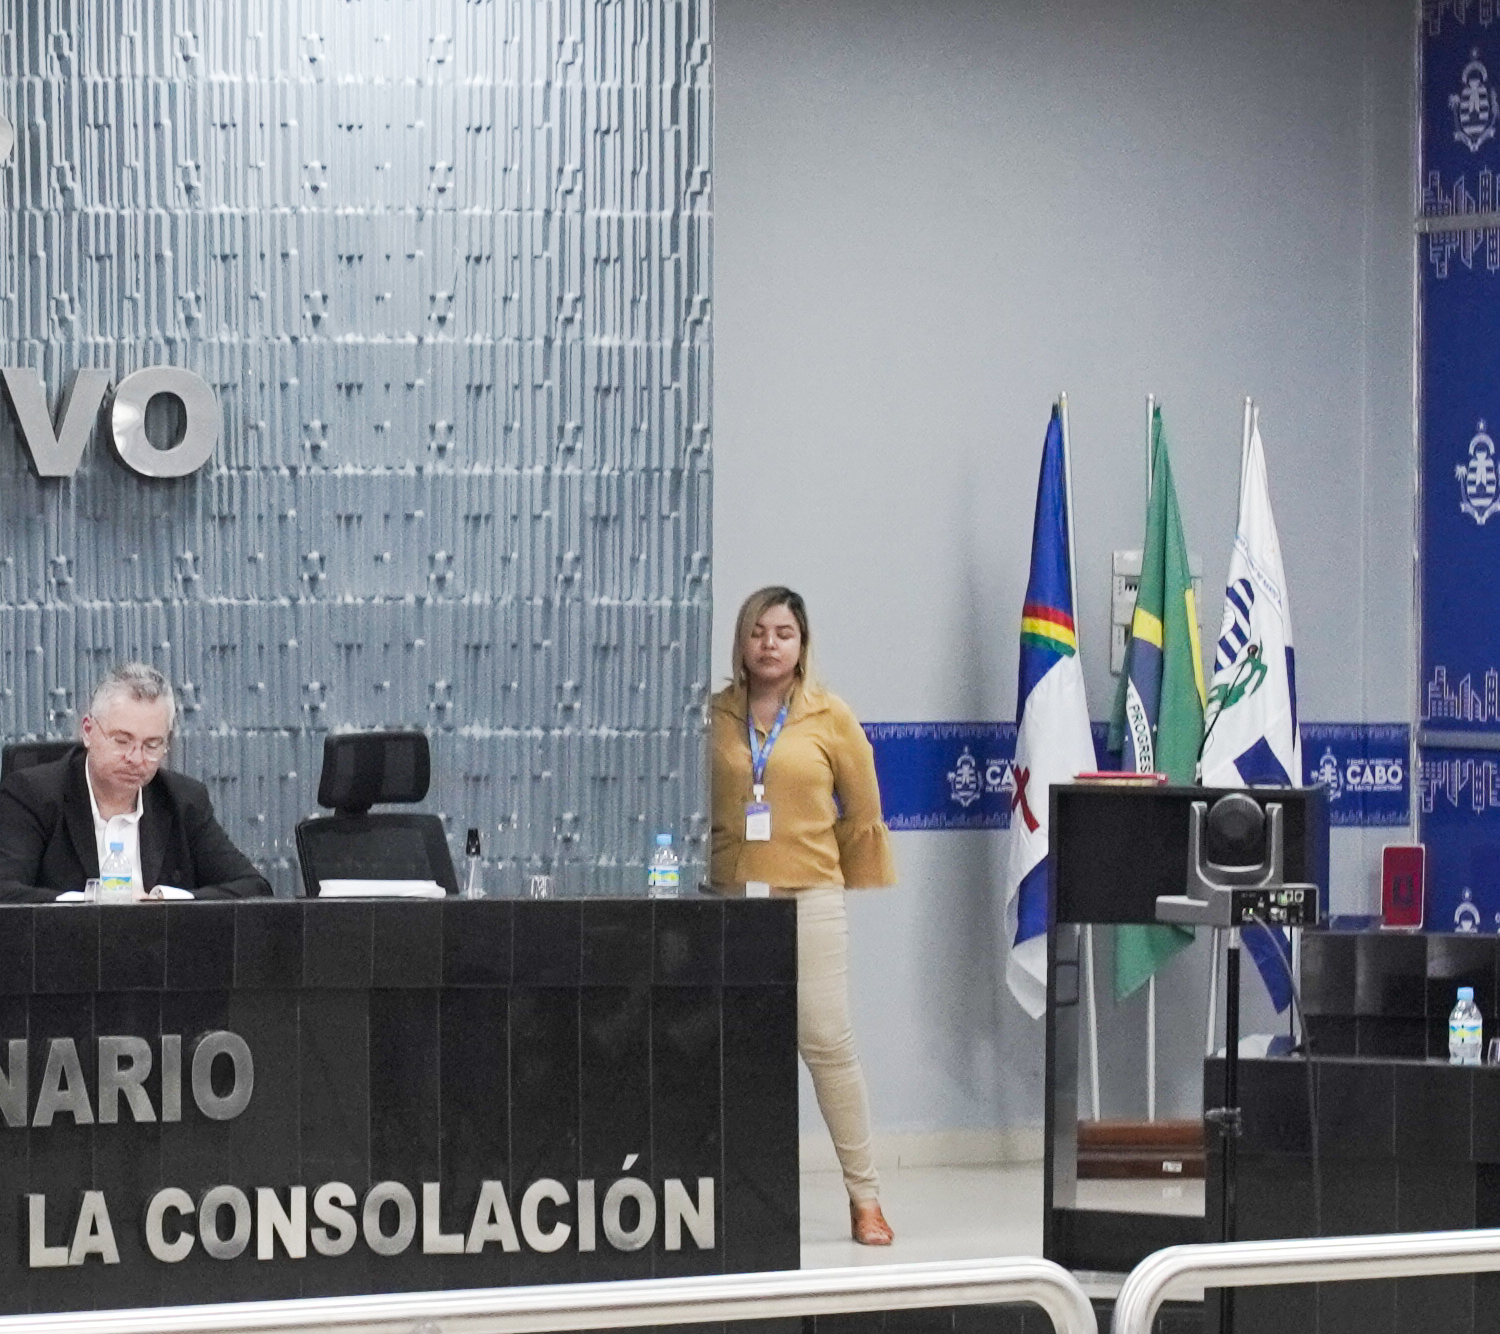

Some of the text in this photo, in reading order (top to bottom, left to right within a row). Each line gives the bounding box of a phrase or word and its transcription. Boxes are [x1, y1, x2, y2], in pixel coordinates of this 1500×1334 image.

[1127, 703, 1152, 773] PROGRES
[985, 765, 1014, 785] CA
[1346, 765, 1403, 785] CABO
[25, 1189, 121, 1268] LA
[144, 1153, 716, 1265] CONSOLACIÓN
